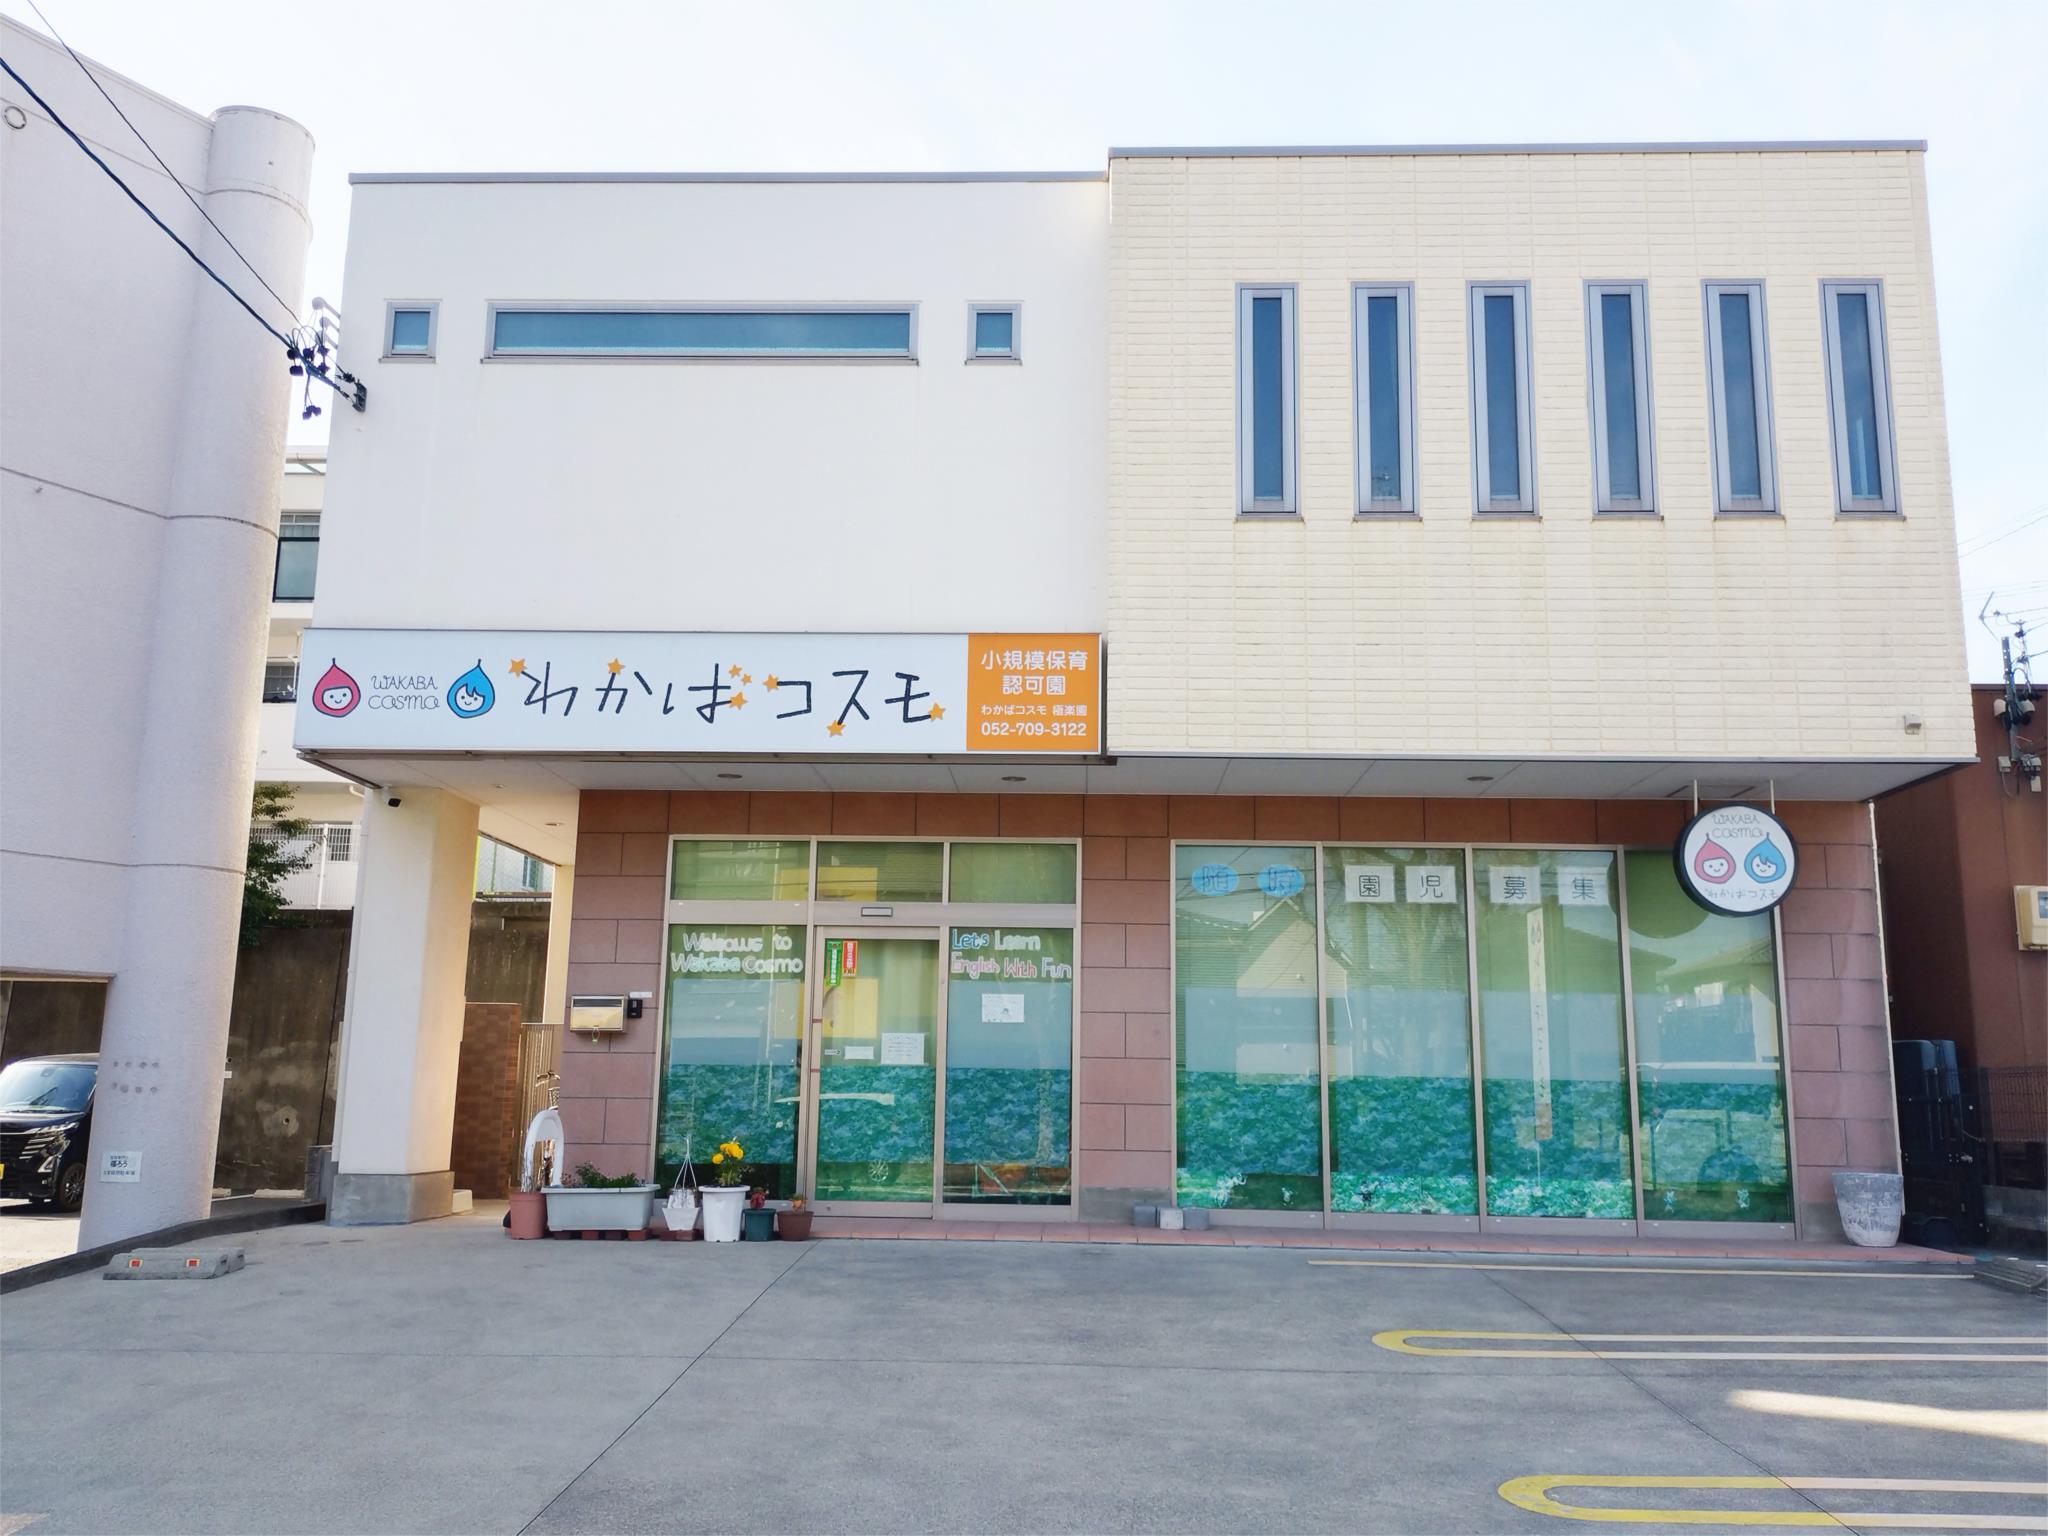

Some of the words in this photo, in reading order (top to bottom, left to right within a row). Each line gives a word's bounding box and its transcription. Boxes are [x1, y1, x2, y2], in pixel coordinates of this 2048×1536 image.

[981, 650, 1089, 671] 小規模保育
[371, 675, 439, 690] WAKABA
[1002, 674, 1067, 696] 認可園
[508, 658, 947, 738] わかばコスモ
[981, 704, 1048, 716] わかばコスモ
[981, 721, 1087, 737] 052-709-3122
[1711, 813, 1761, 825] WAKABA
[774, 932, 793, 951] to
[950, 951, 1001, 980] English
[1003, 957, 1038, 978] With
[1041, 956, 1073, 979] Fun
